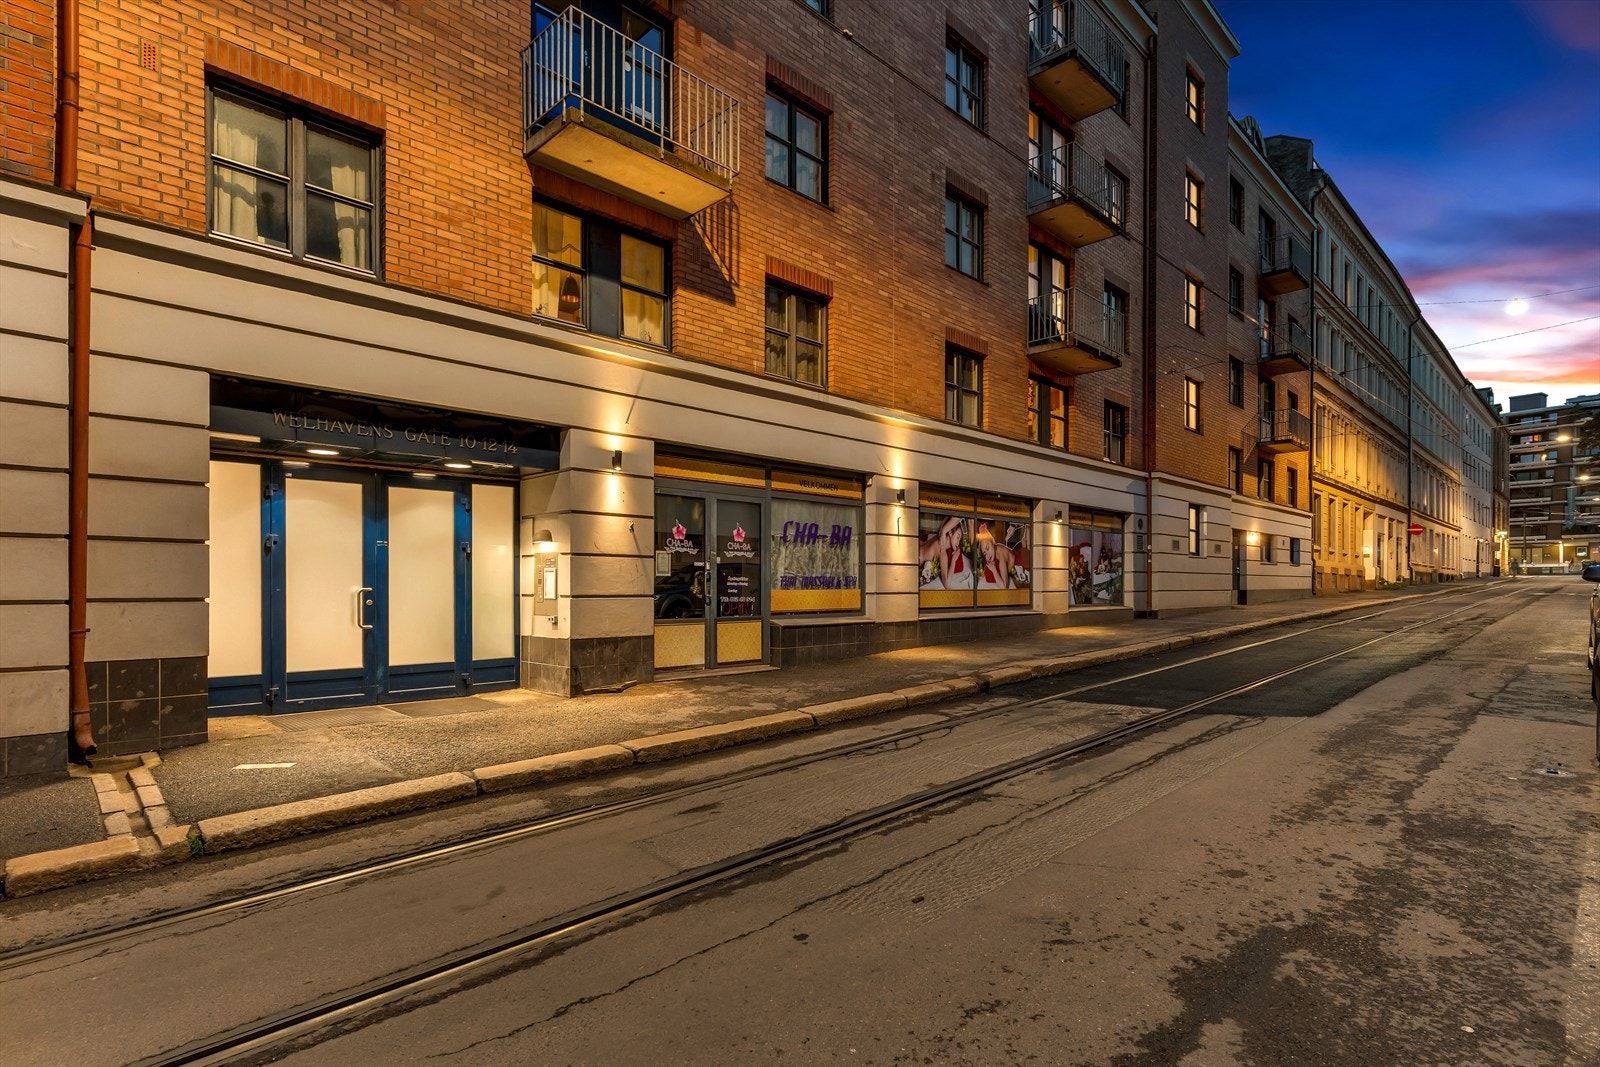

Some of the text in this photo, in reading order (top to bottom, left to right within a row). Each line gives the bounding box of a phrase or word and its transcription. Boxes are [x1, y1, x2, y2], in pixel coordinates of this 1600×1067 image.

[273, 409, 394, 439] WELHAVENS
[404, 427, 451, 447] GATE
[799, 480, 839, 491] VELKOMMEN
[782, 520, 852, 546] CHA-BA
[666, 538, 694, 548] CHA-BA
[727, 542, 751, 551] CHA-BA
